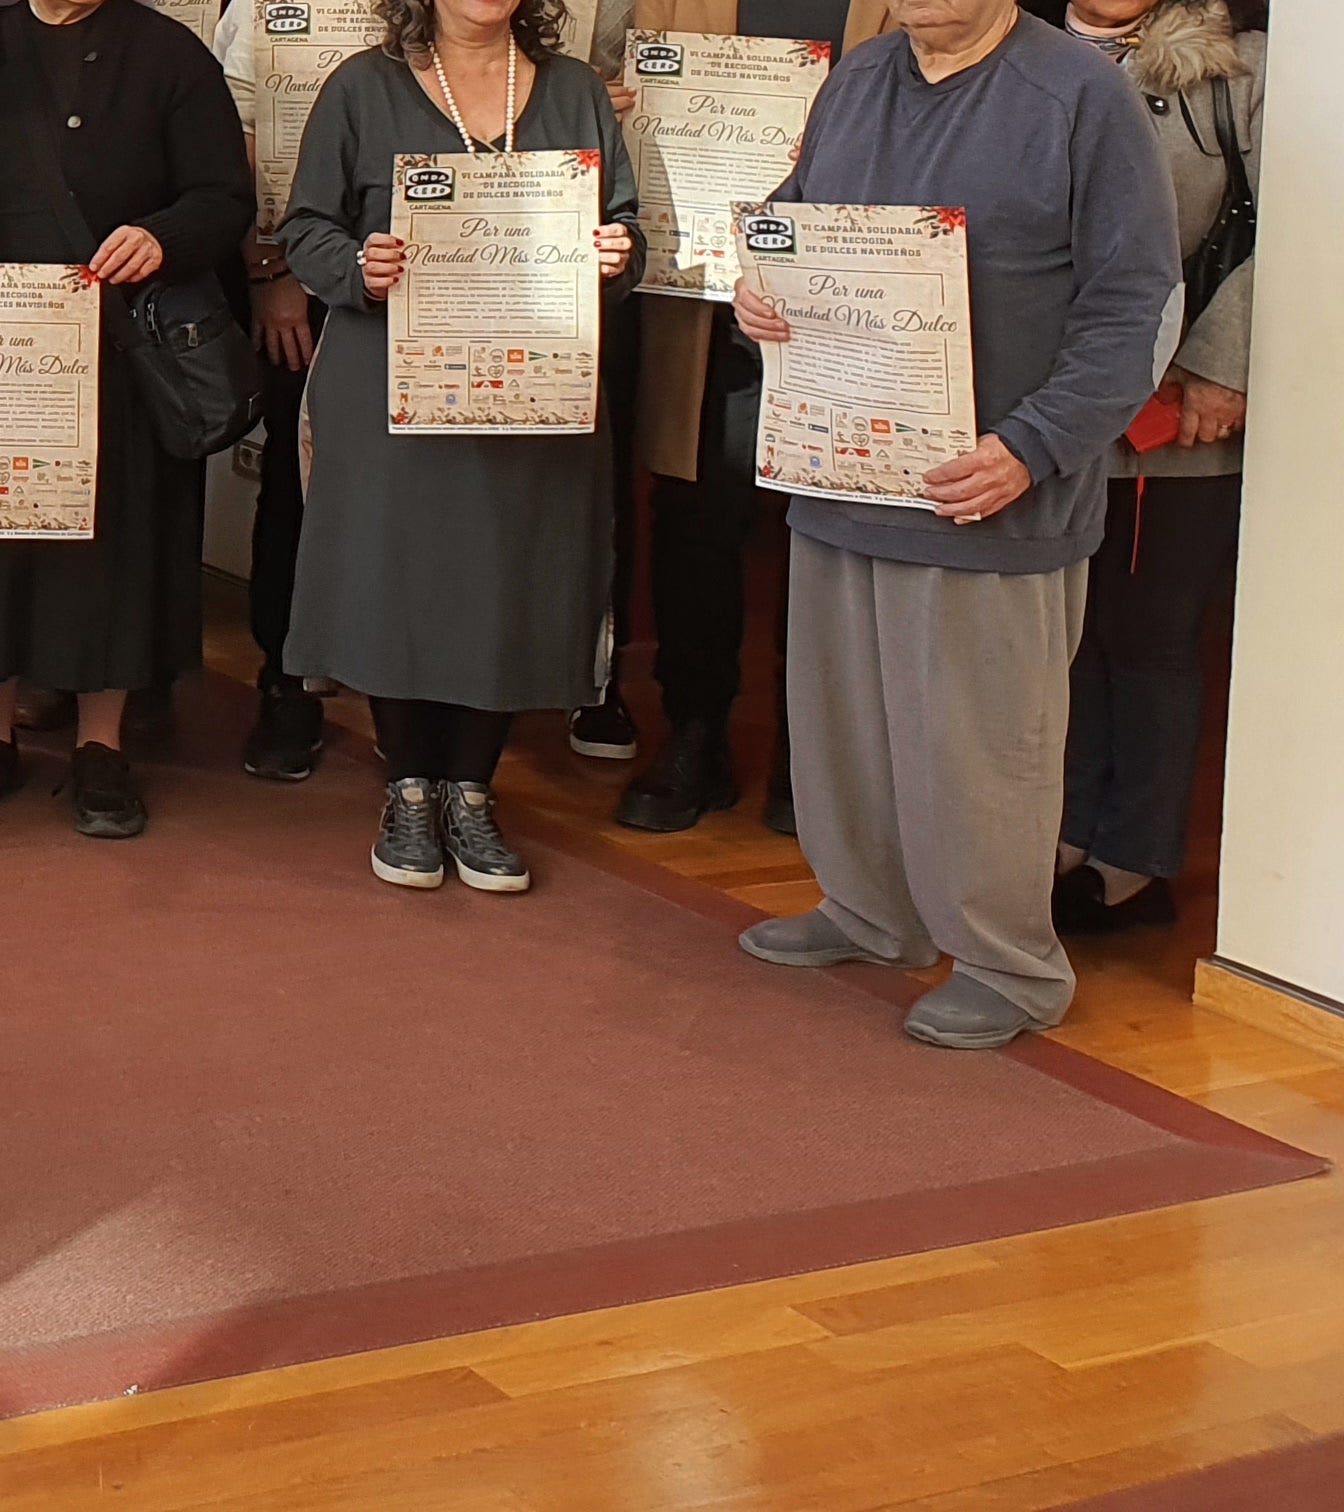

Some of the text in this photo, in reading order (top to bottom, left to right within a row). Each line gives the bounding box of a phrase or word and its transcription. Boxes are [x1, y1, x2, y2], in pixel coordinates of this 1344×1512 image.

[687, 95, 757, 117] Por una
[633, 116, 706, 137] Navidad
[708, 120, 755, 143] Más
[413, 187, 445, 195] CERO
[460, 218, 531, 238] Por una
[752, 222, 789, 233] ONDA
[801, 223, 811, 231] VI
[867, 226, 923, 235] SOLIDARIA
[755, 236, 787, 246] CERO
[842, 236, 893, 245] RECOGIDA
[403, 244, 588, 266] Navidad Más Dulce
[805, 245, 922, 257] DE DULCES NAVIDEÑOS
[754, 255, 795, 264] CARTAGENA
[809, 274, 887, 299] Por una
[16, 301, 65, 309] NAVIDEÑOS
[762, 295, 958, 332] Navidad Más Dulce
[9, 336, 34, 347] una
[38, 354, 89, 375] Dulce
